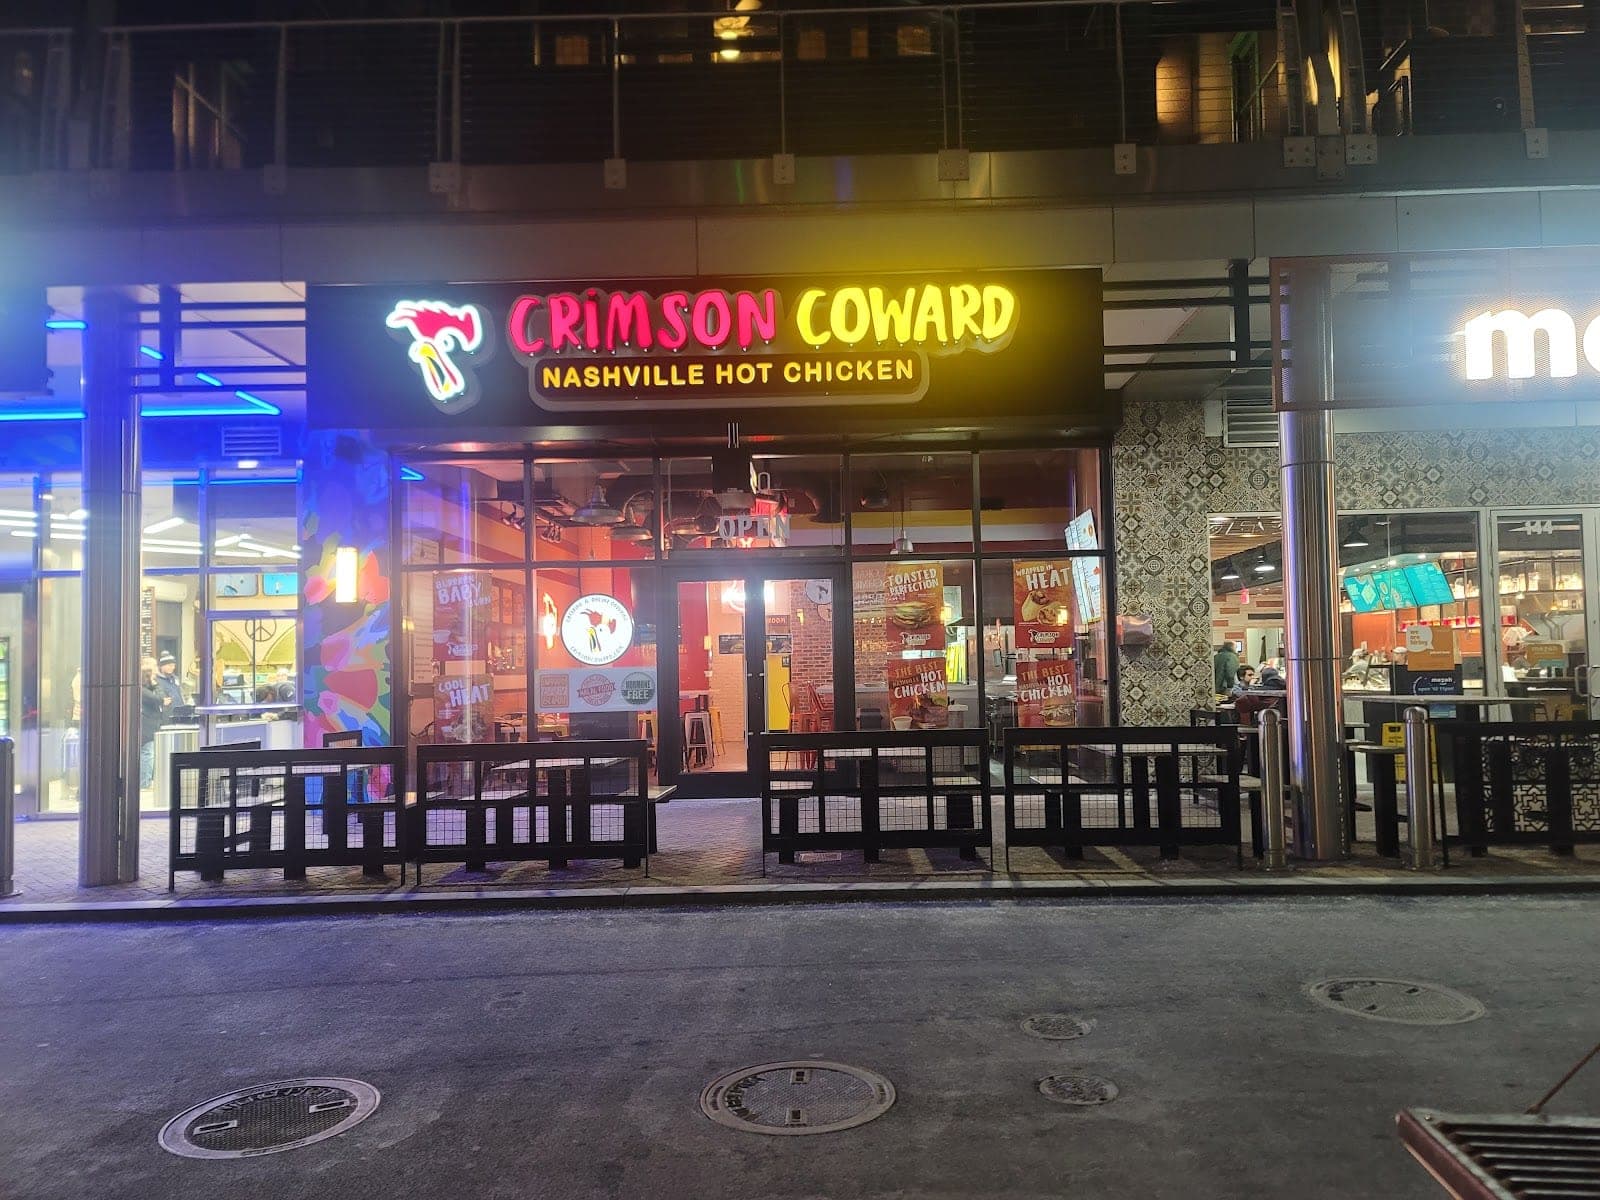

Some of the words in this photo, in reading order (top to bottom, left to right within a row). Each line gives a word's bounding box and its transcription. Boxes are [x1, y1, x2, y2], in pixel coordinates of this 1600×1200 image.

[797, 283, 1015, 347] COWARD
[542, 362, 705, 389] NASHVILLE
[715, 361, 774, 385] HOT
[783, 359, 915, 384] CHICKEN
[719, 514, 791, 540] OPEN
[888, 568, 937, 587] TOASTED
[1015, 566, 1045, 577] WRAPPED
[1026, 567, 1071, 591] HEAT
[889, 579, 939, 596] PERFECTION
[895, 664, 913, 677] THE
[917, 661, 938, 673] BEST
[920, 670, 942, 682] HOT
[1041, 664, 1065, 677] BEST
[894, 680, 946, 699] CHICKEN
[1047, 673, 1070, 687] HOT
[449, 683, 491, 707] HEAT
[627, 689, 649, 699] FREE
[1020, 683, 1073, 702] CHICKEN
